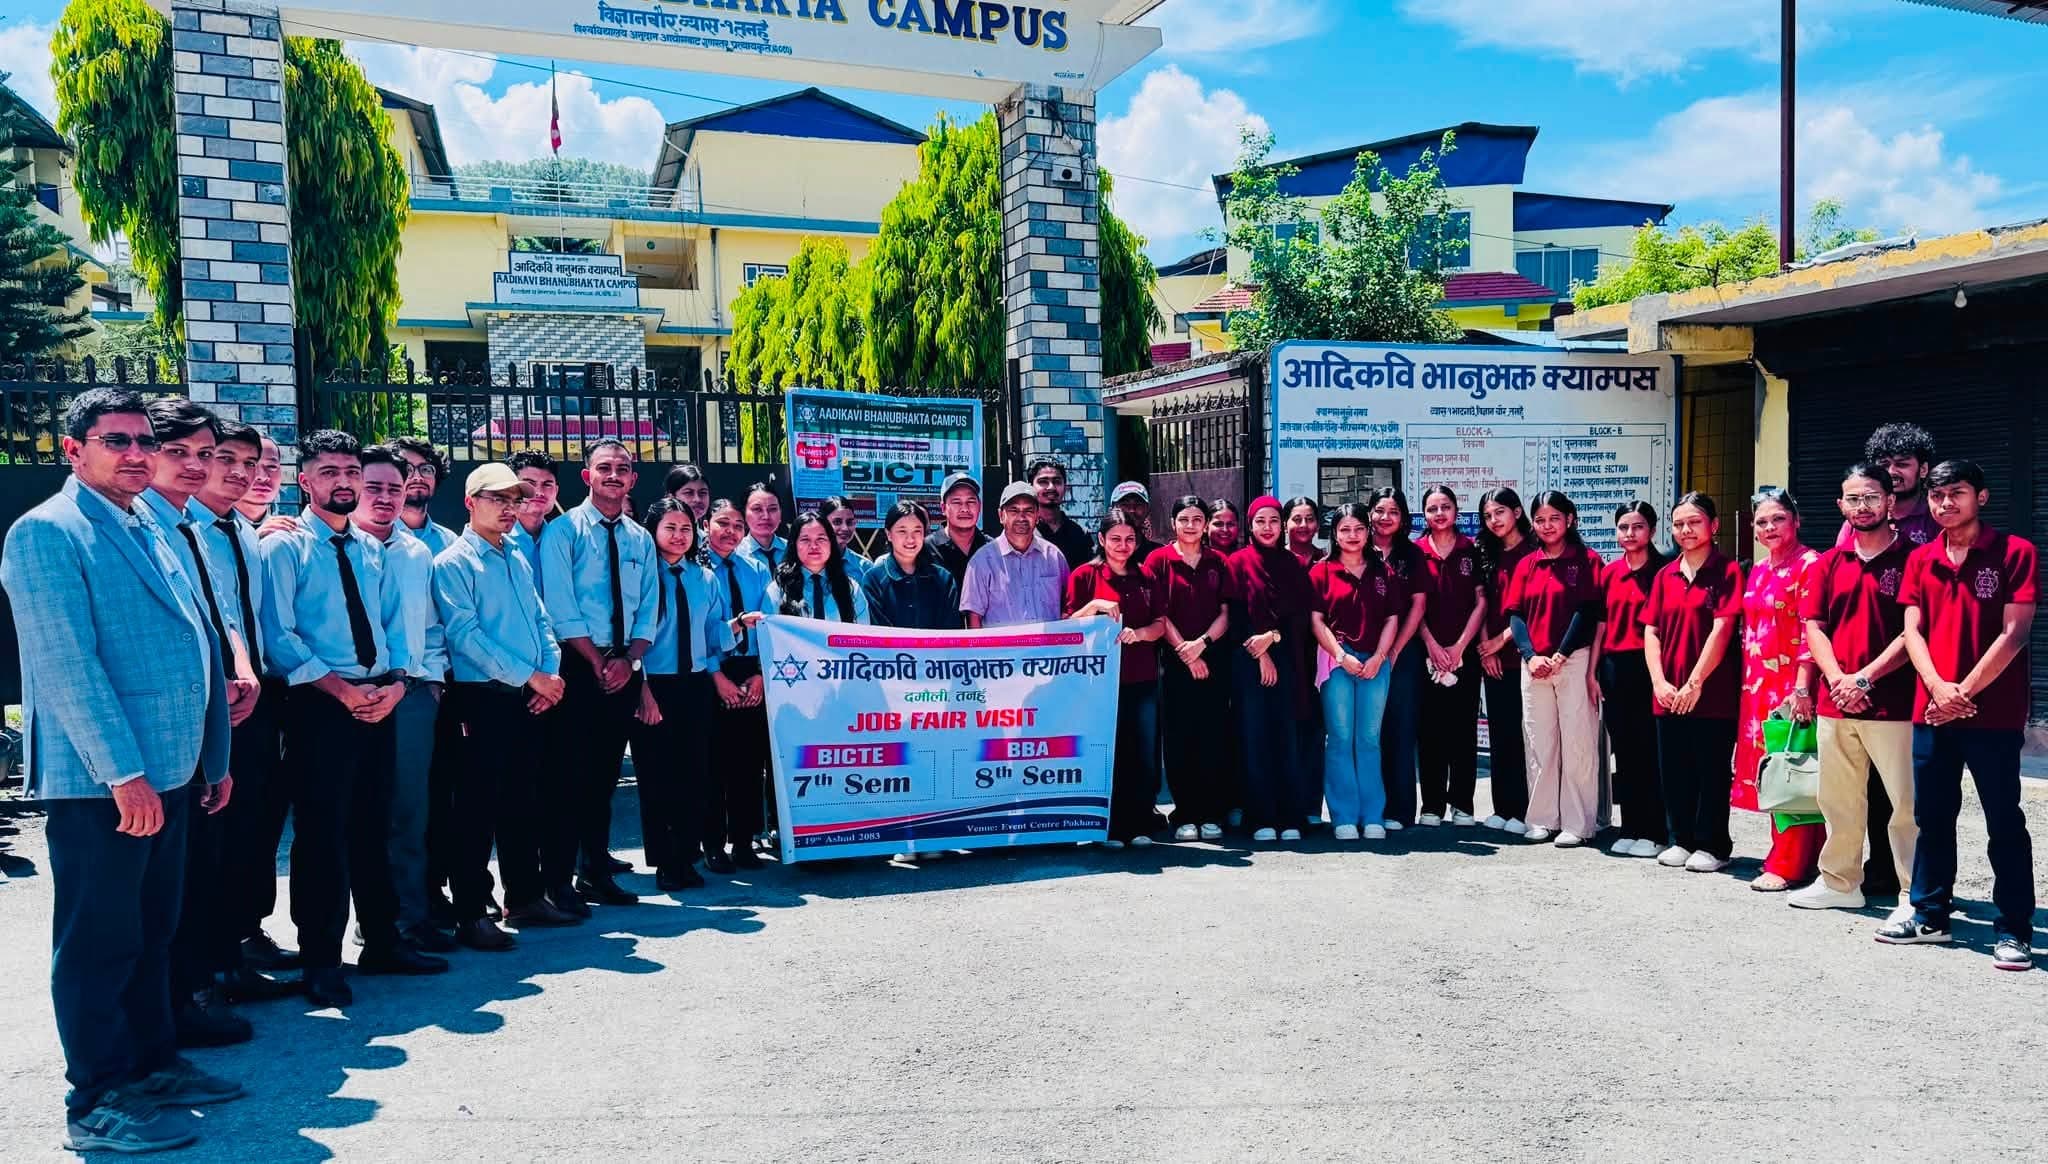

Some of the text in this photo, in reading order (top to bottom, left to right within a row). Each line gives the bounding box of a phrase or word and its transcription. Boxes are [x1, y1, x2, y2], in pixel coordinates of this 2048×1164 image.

[868, 0, 1069, 51] CAMPUS
[514, 260, 620, 277] आदिकवि भानुभक्त क्याम्पस
[497, 274, 640, 290] AADIKAVI BHANUBHAKTA CAMPUS
[1282, 350, 1661, 400] आदिकवि भानुभक्त क्याम्पस
[819, 407, 967, 427] AADIKAVI BHANUBHAKTA CAMPUS
[1456, 426, 1494, 437] BLOCK-A
[799, 448, 833, 457] ADMISSION
[808, 458, 825, 466] OPEN
[842, 450, 970, 463] TRIBHUVAN UNIVERSITY ADMISSIONS OPEN
[817, 652, 1108, 687] आदिकवि भानुभक्त क्याम्पस
[848, 707, 1039, 733] JOB FAIR VISIT
[817, 747, 885, 767] BICTE
[1007, 740, 1050, 759] BBA
[793, 772, 911, 799] 7th Sem
[975, 765, 1082, 789] 8th Sem
[966, 824, 998, 833] Venue:
[1001, 822, 1027, 831] Event
[1030, 820, 1060, 829] Centre
[825, 833, 856, 844] Ashad
[858, 831, 881, 841] 2083
